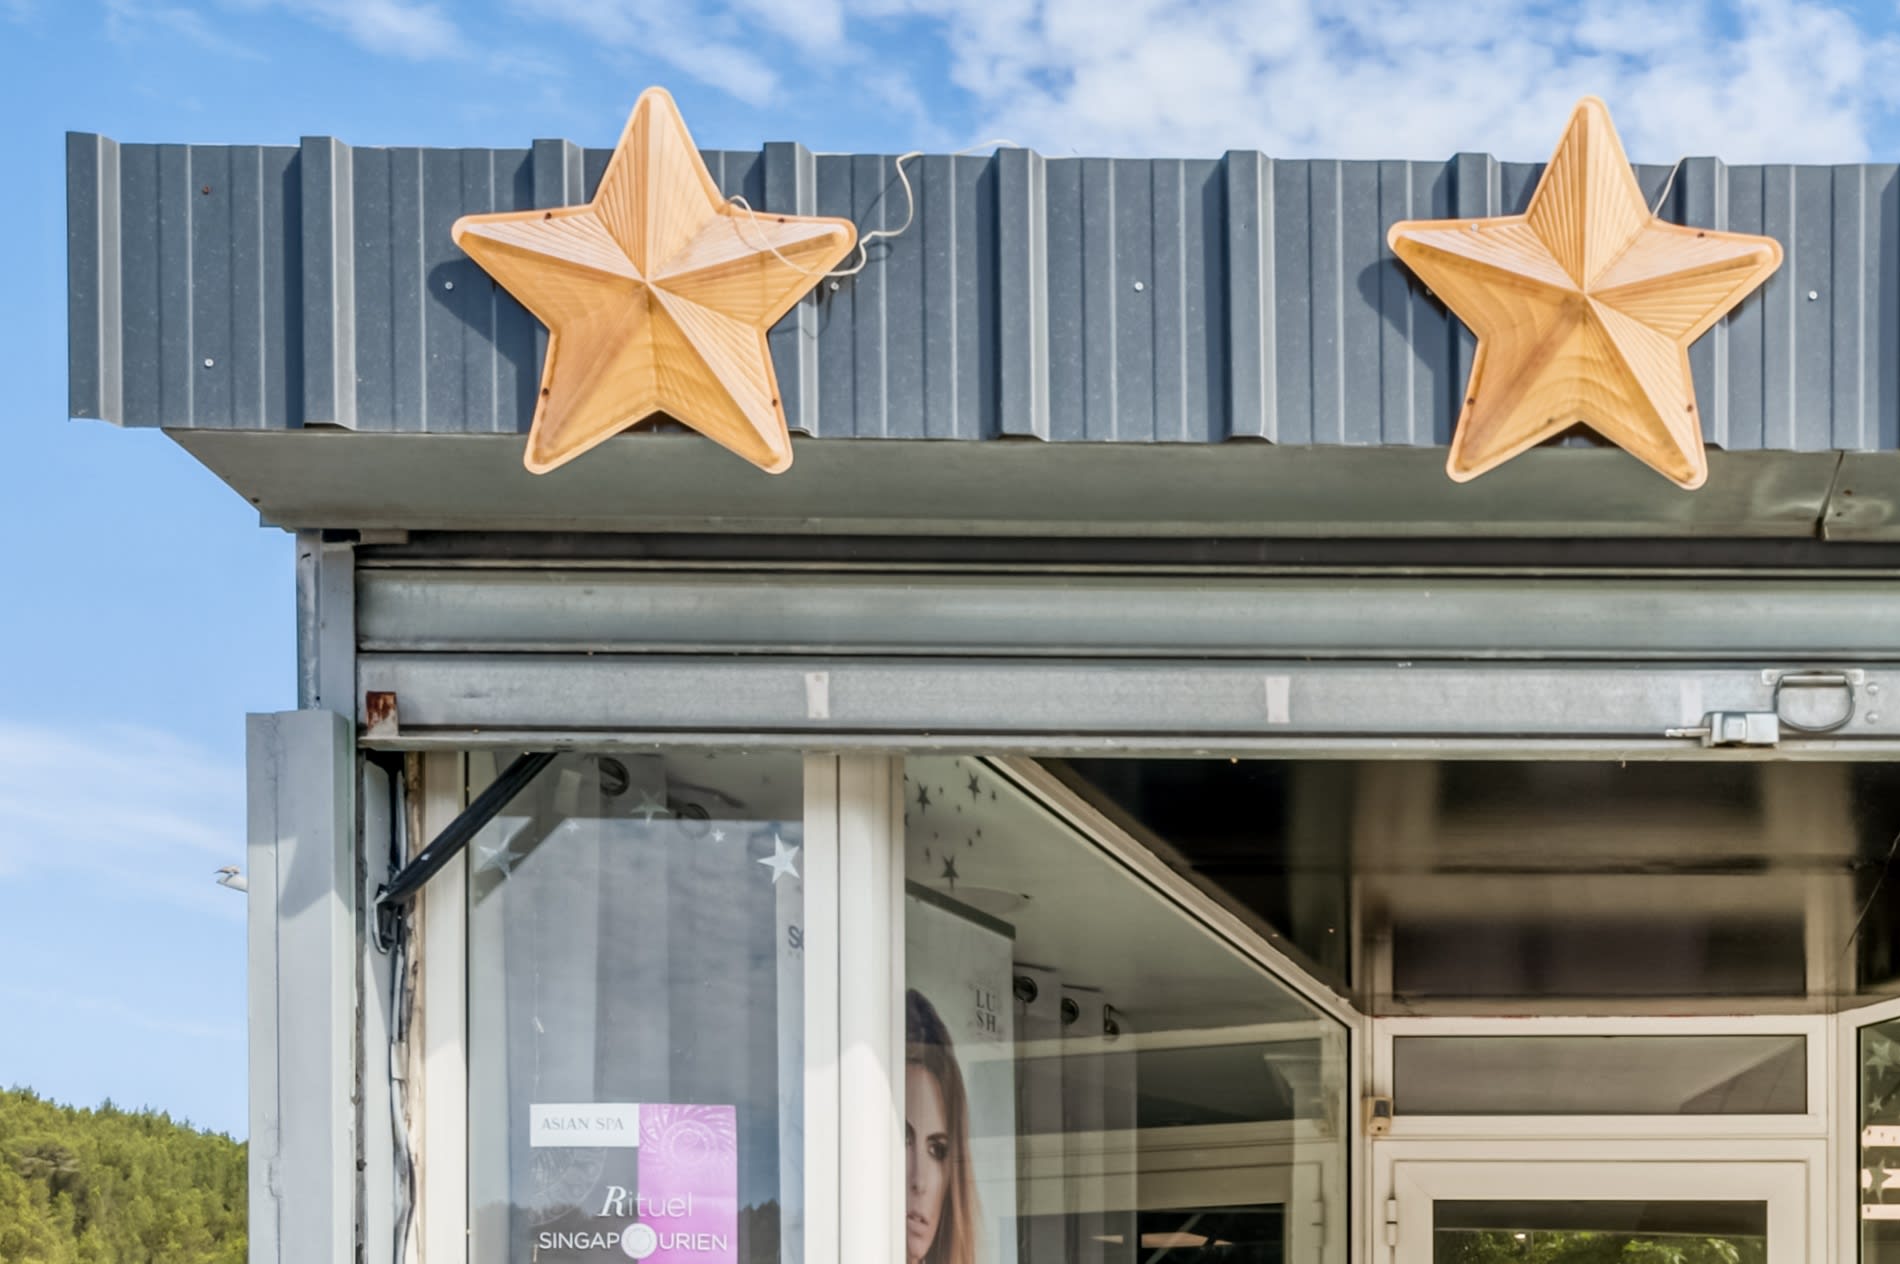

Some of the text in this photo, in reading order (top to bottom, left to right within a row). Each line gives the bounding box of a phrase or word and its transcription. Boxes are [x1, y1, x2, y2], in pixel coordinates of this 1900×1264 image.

[541, 1118, 624, 1131] ASIAN SPA
[597, 1185, 692, 1218] Rituel
